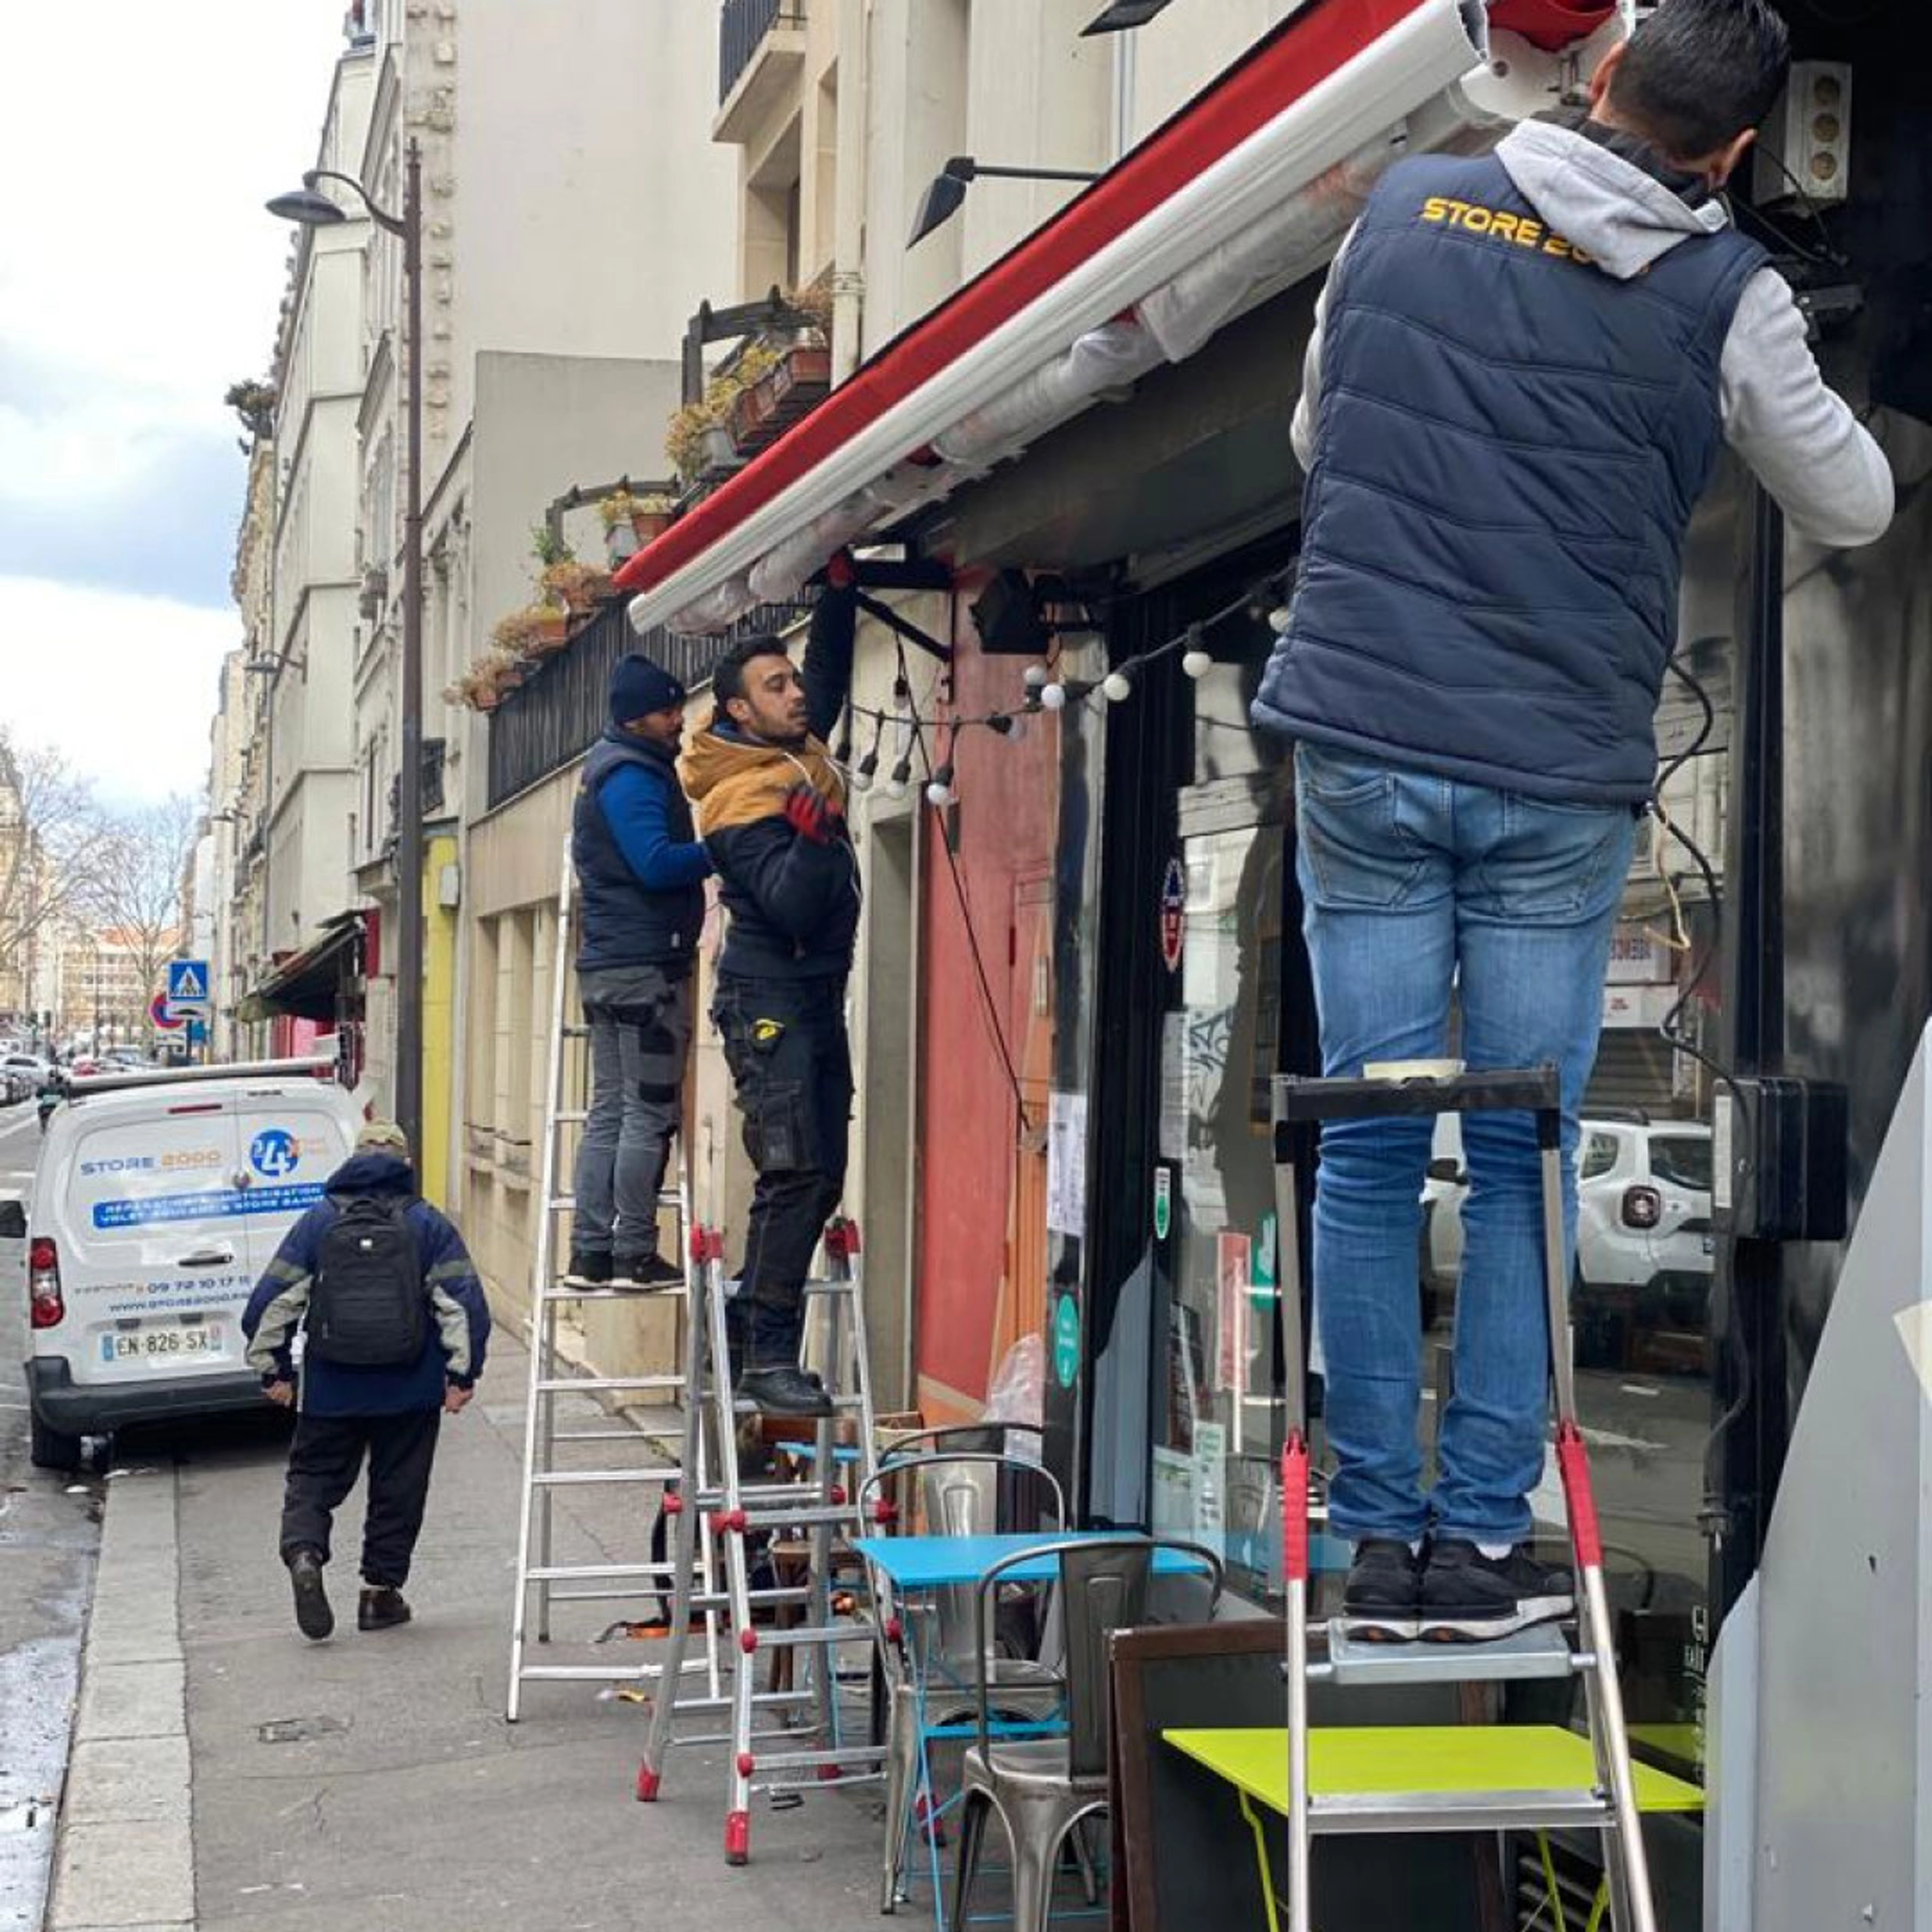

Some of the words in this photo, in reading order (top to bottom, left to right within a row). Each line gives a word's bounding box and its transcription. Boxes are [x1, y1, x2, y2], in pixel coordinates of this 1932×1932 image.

[1422, 197, 1543, 247] STORE
[80, 1157, 155, 1175] STORE
[161, 1150, 220, 1167] 2000
